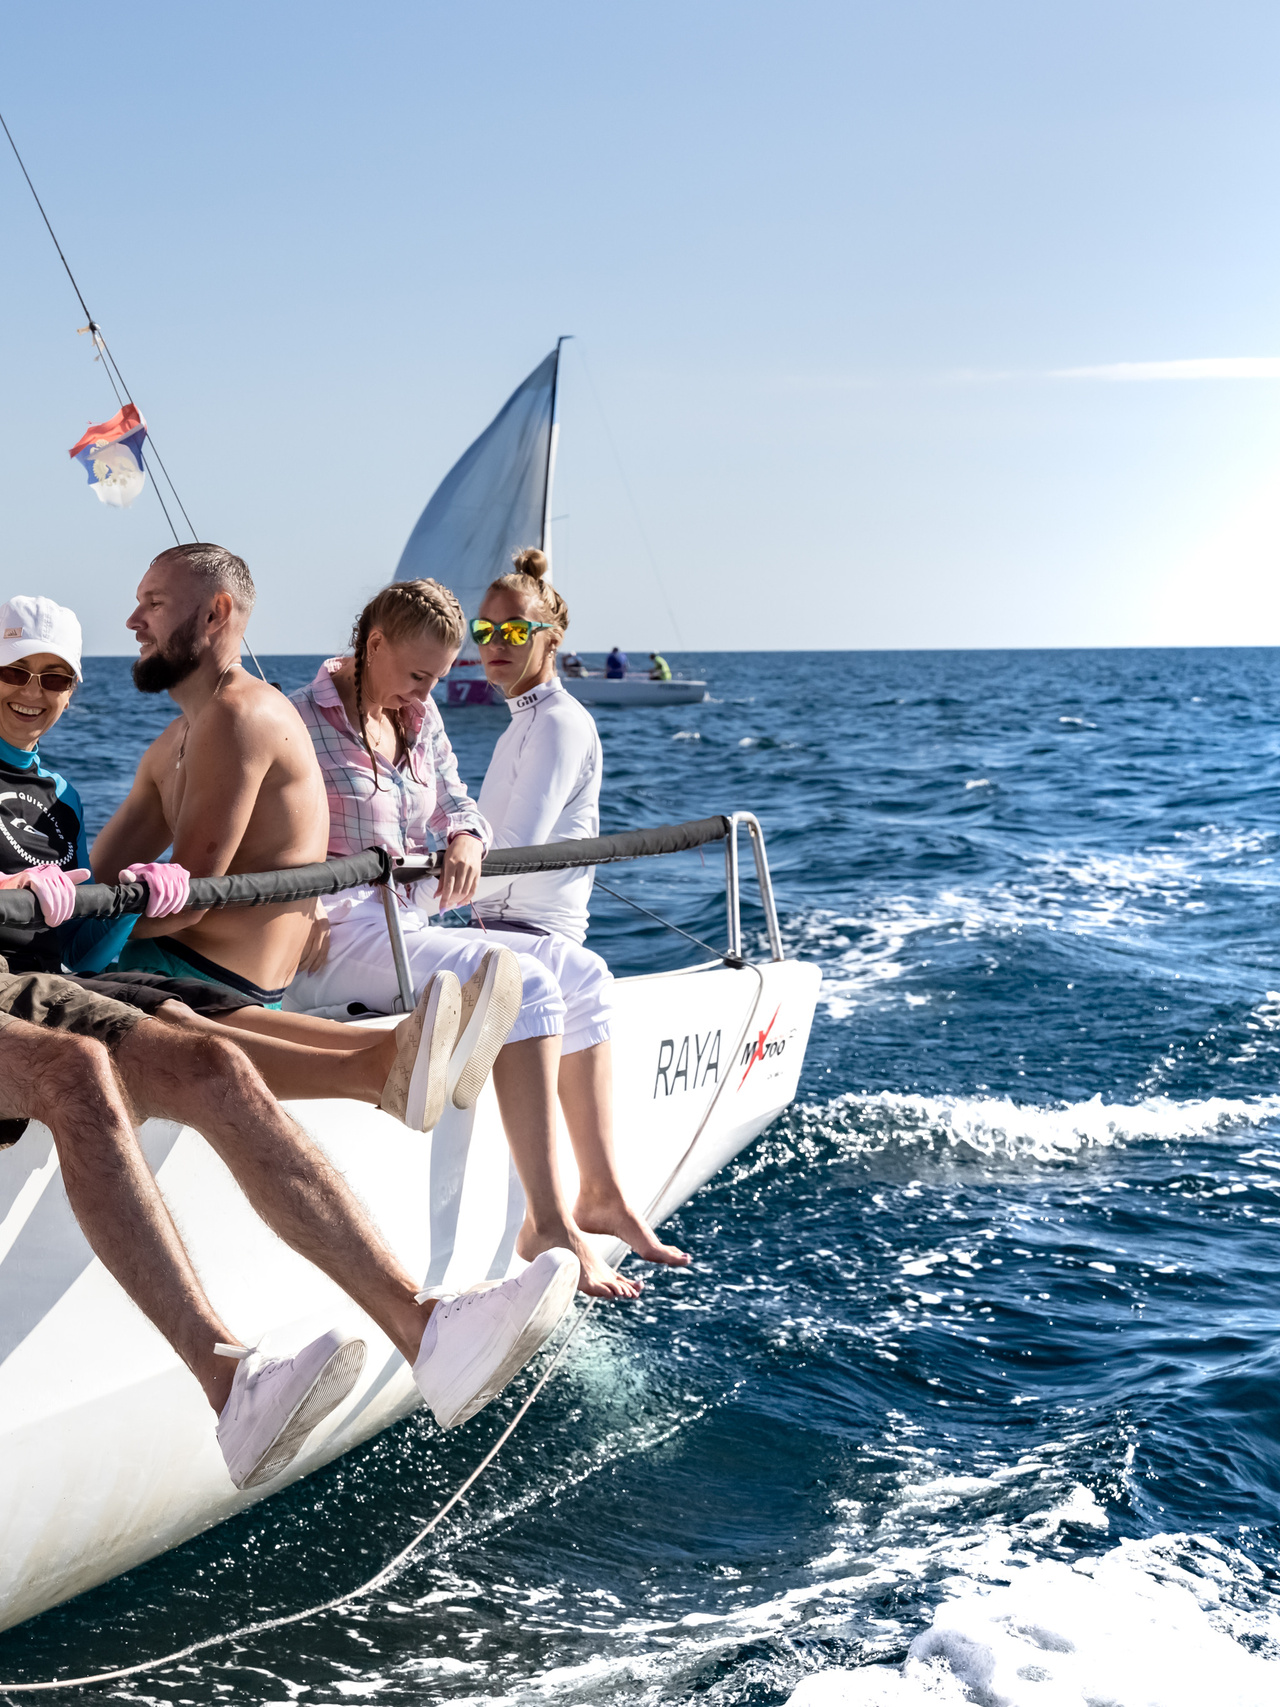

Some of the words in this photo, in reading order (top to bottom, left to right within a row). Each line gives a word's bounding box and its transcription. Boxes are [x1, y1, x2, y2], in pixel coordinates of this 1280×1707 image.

[456, 683, 471, 701] 7
[516, 693, 538, 708] Gill
[18, 792, 64, 840] QUIKSILVER
[653, 1029, 721, 1099] RAYA
